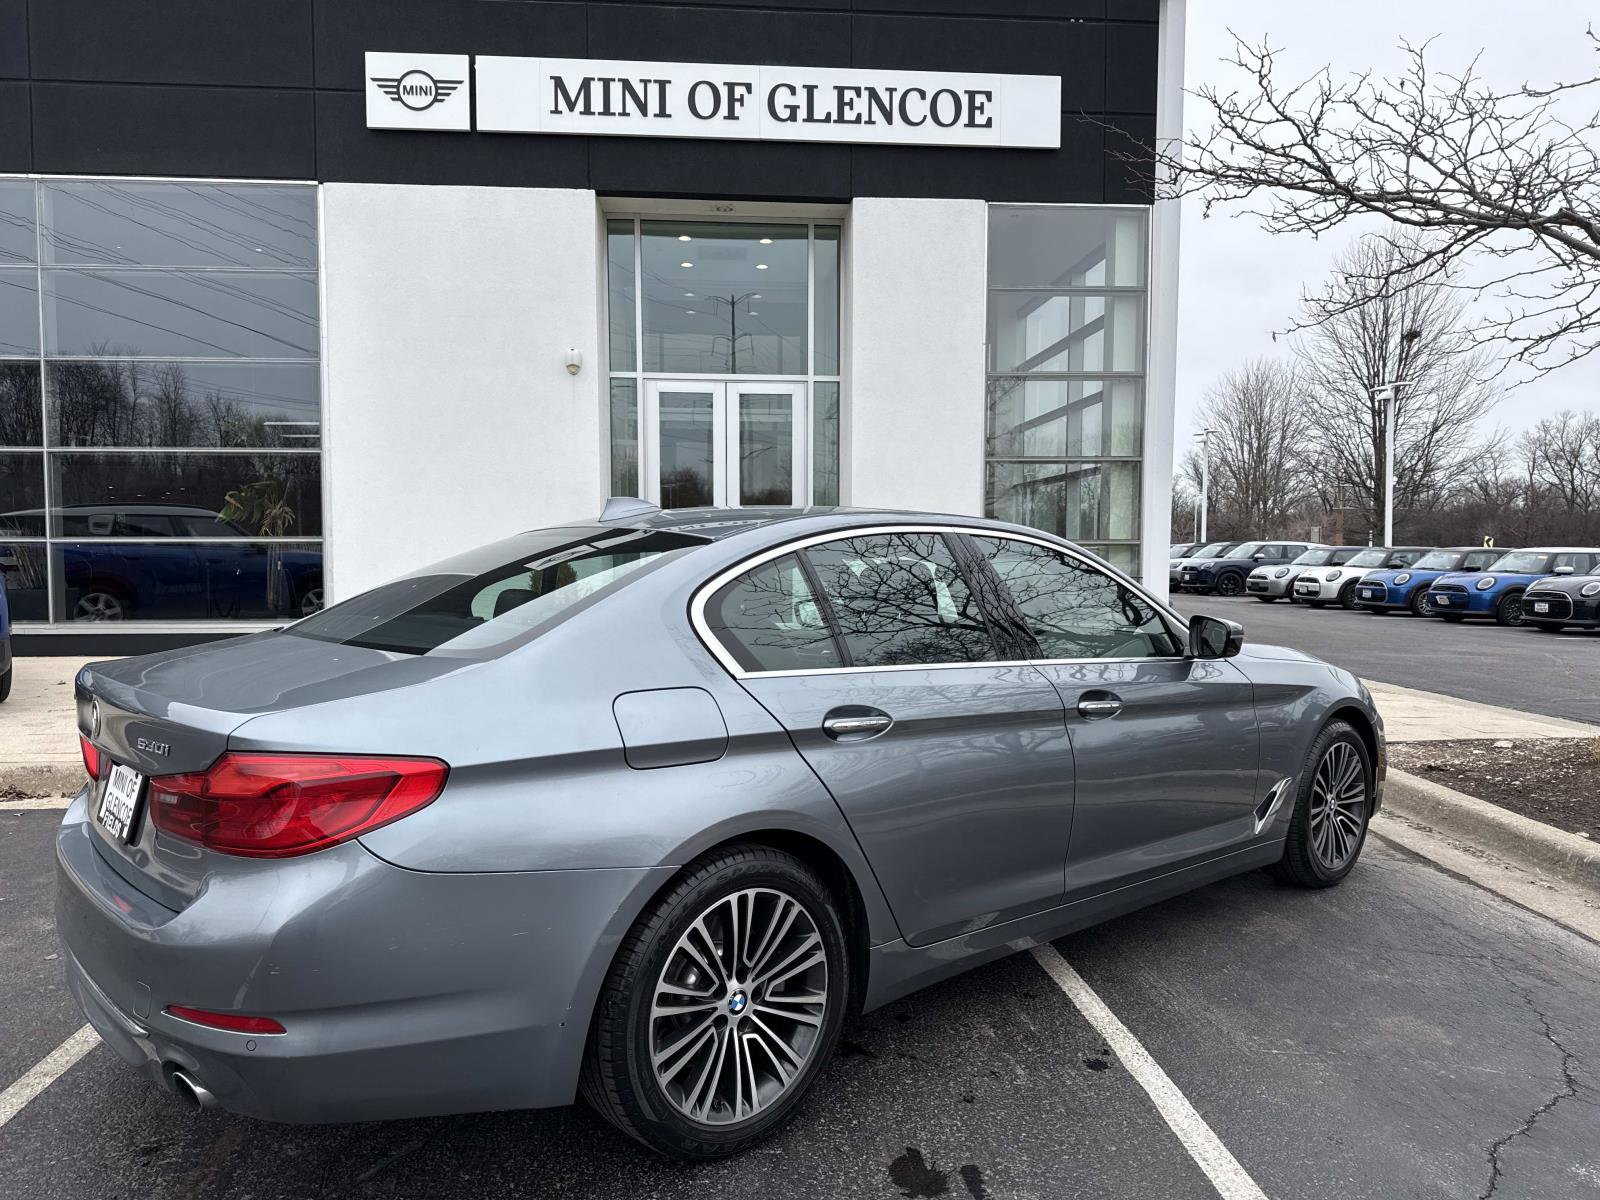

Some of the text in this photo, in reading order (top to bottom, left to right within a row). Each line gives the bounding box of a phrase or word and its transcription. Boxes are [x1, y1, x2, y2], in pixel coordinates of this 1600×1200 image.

[403, 85, 433, 96] MINI
[550, 76, 993, 128] MINI OF GLENCOE
[137, 738, 169, 757] 530i
[112, 768, 138, 799] MINI OF
[106, 791, 133, 827] GLENCOE
[102, 810, 122, 839] FIELDS
